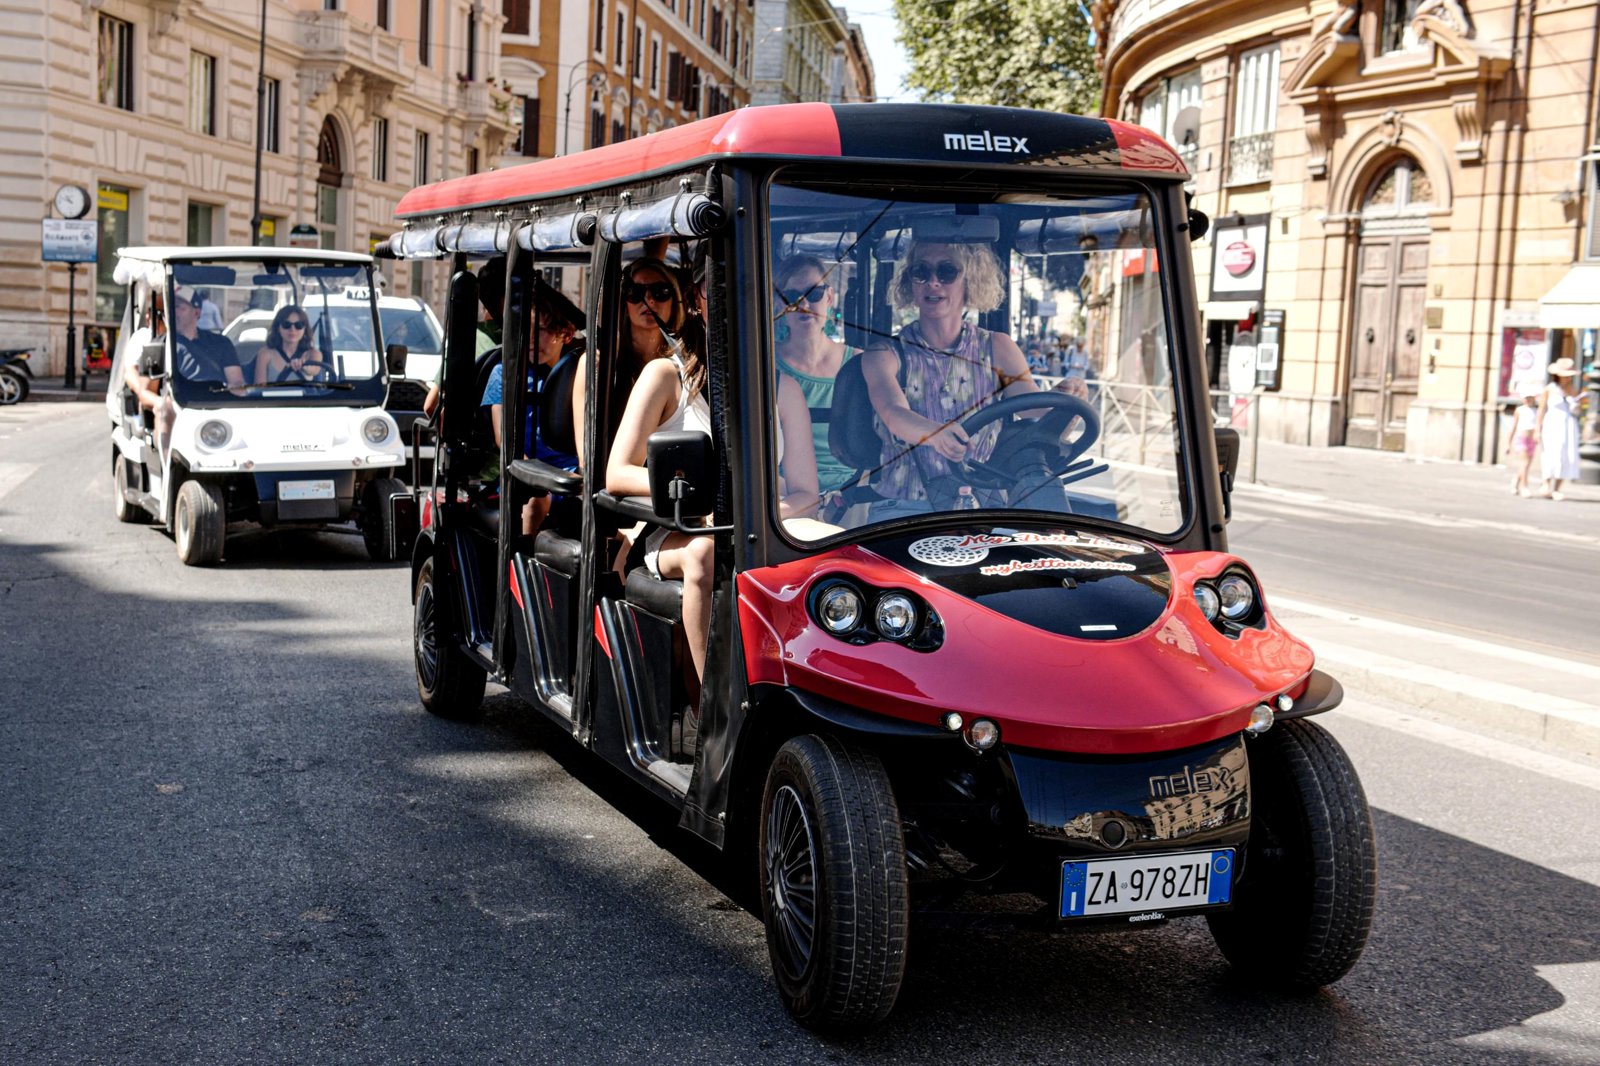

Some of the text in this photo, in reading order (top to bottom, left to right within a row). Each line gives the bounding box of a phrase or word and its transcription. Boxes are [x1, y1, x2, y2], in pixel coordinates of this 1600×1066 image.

[943, 130, 1031, 154] melex
[958, 534, 1008, 547] My
[1015, 533, 1078, 545] Best
[981, 558, 1136, 575] mybesttour.com
[1149, 765, 1231, 797] melex
